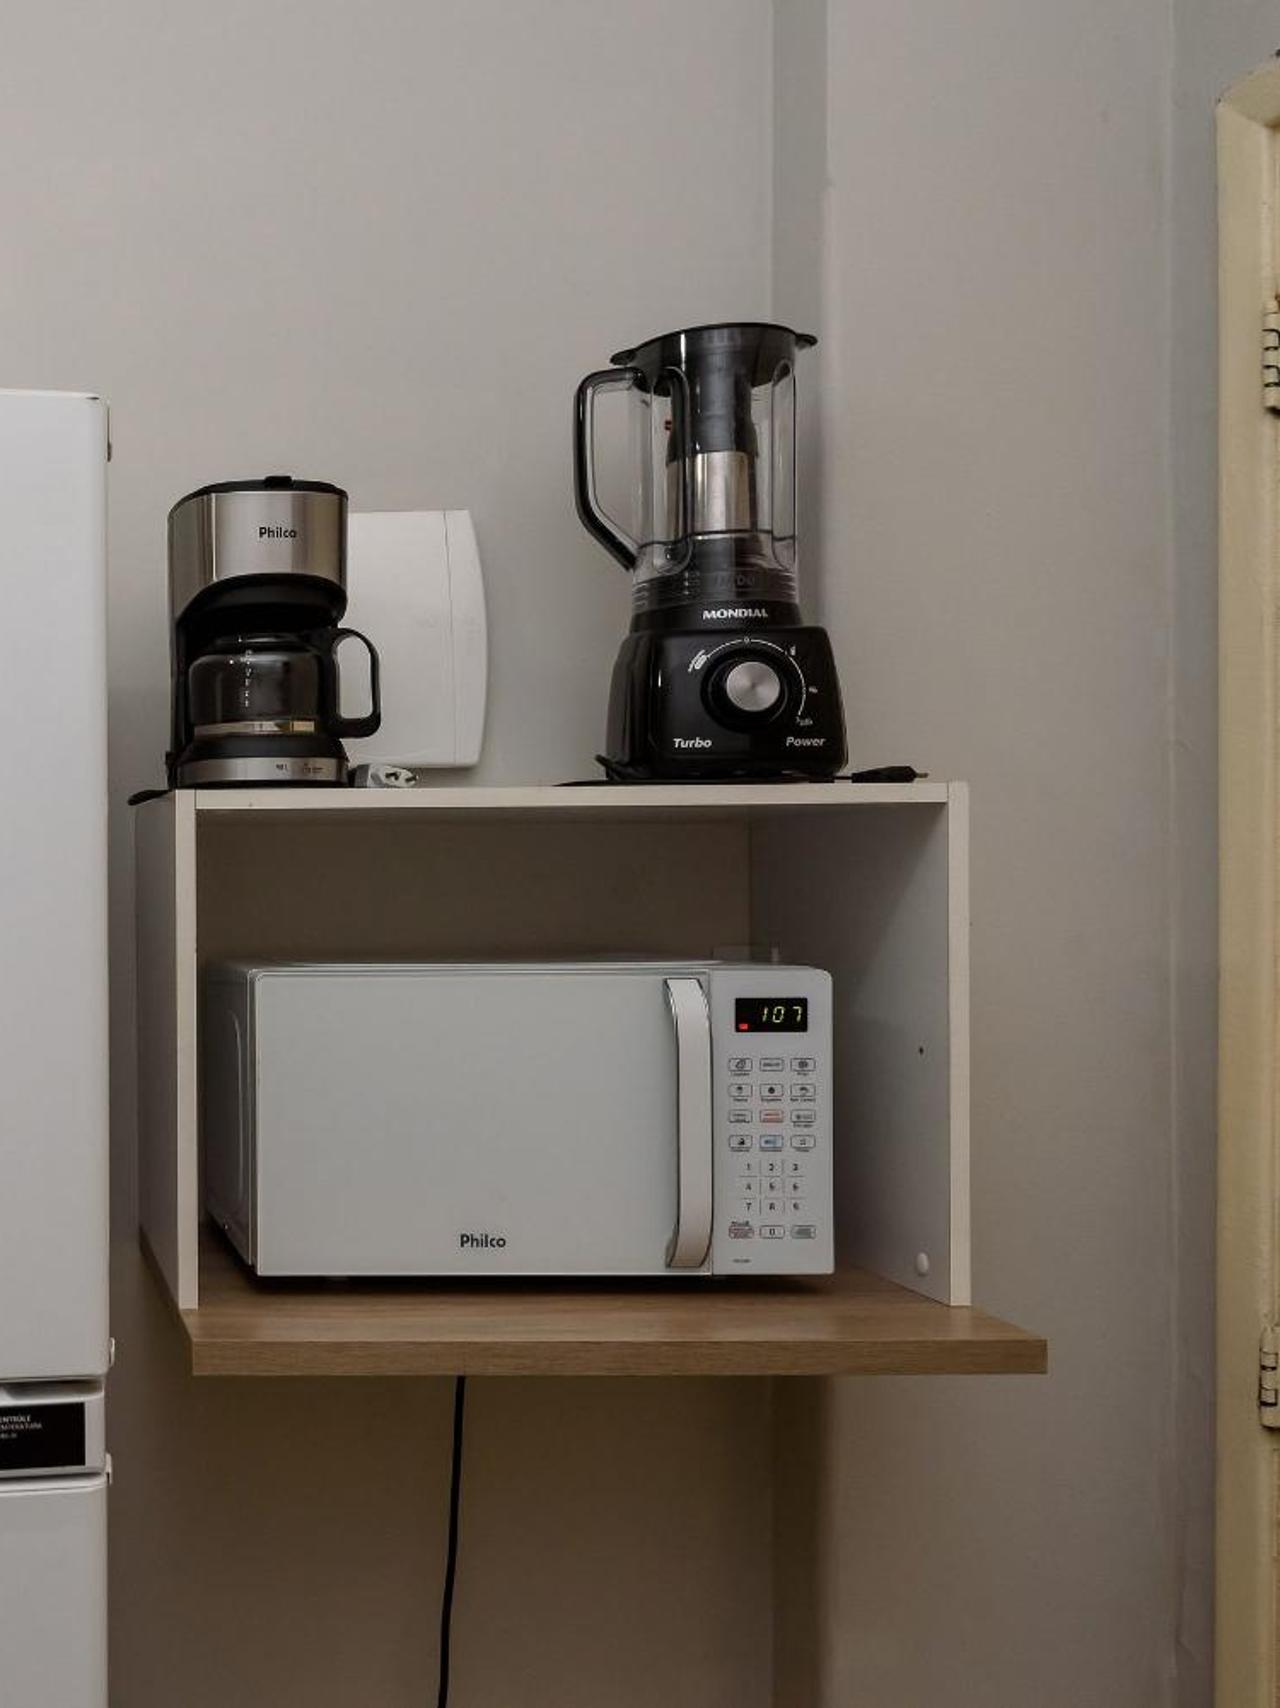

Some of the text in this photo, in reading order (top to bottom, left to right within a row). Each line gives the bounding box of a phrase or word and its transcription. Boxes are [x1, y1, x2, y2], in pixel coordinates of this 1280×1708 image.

[259, 526, 298, 538] Philco
[702, 607, 769, 620] MONDIAL
[673, 737, 713, 749] Turbo
[786, 736, 826, 747] Power
[769, 1163, 775, 1171] 2
[793, 1163, 799, 1171] 3
[769, 1228, 776, 1236] 0
[460, 1232, 506, 1248] Philco
